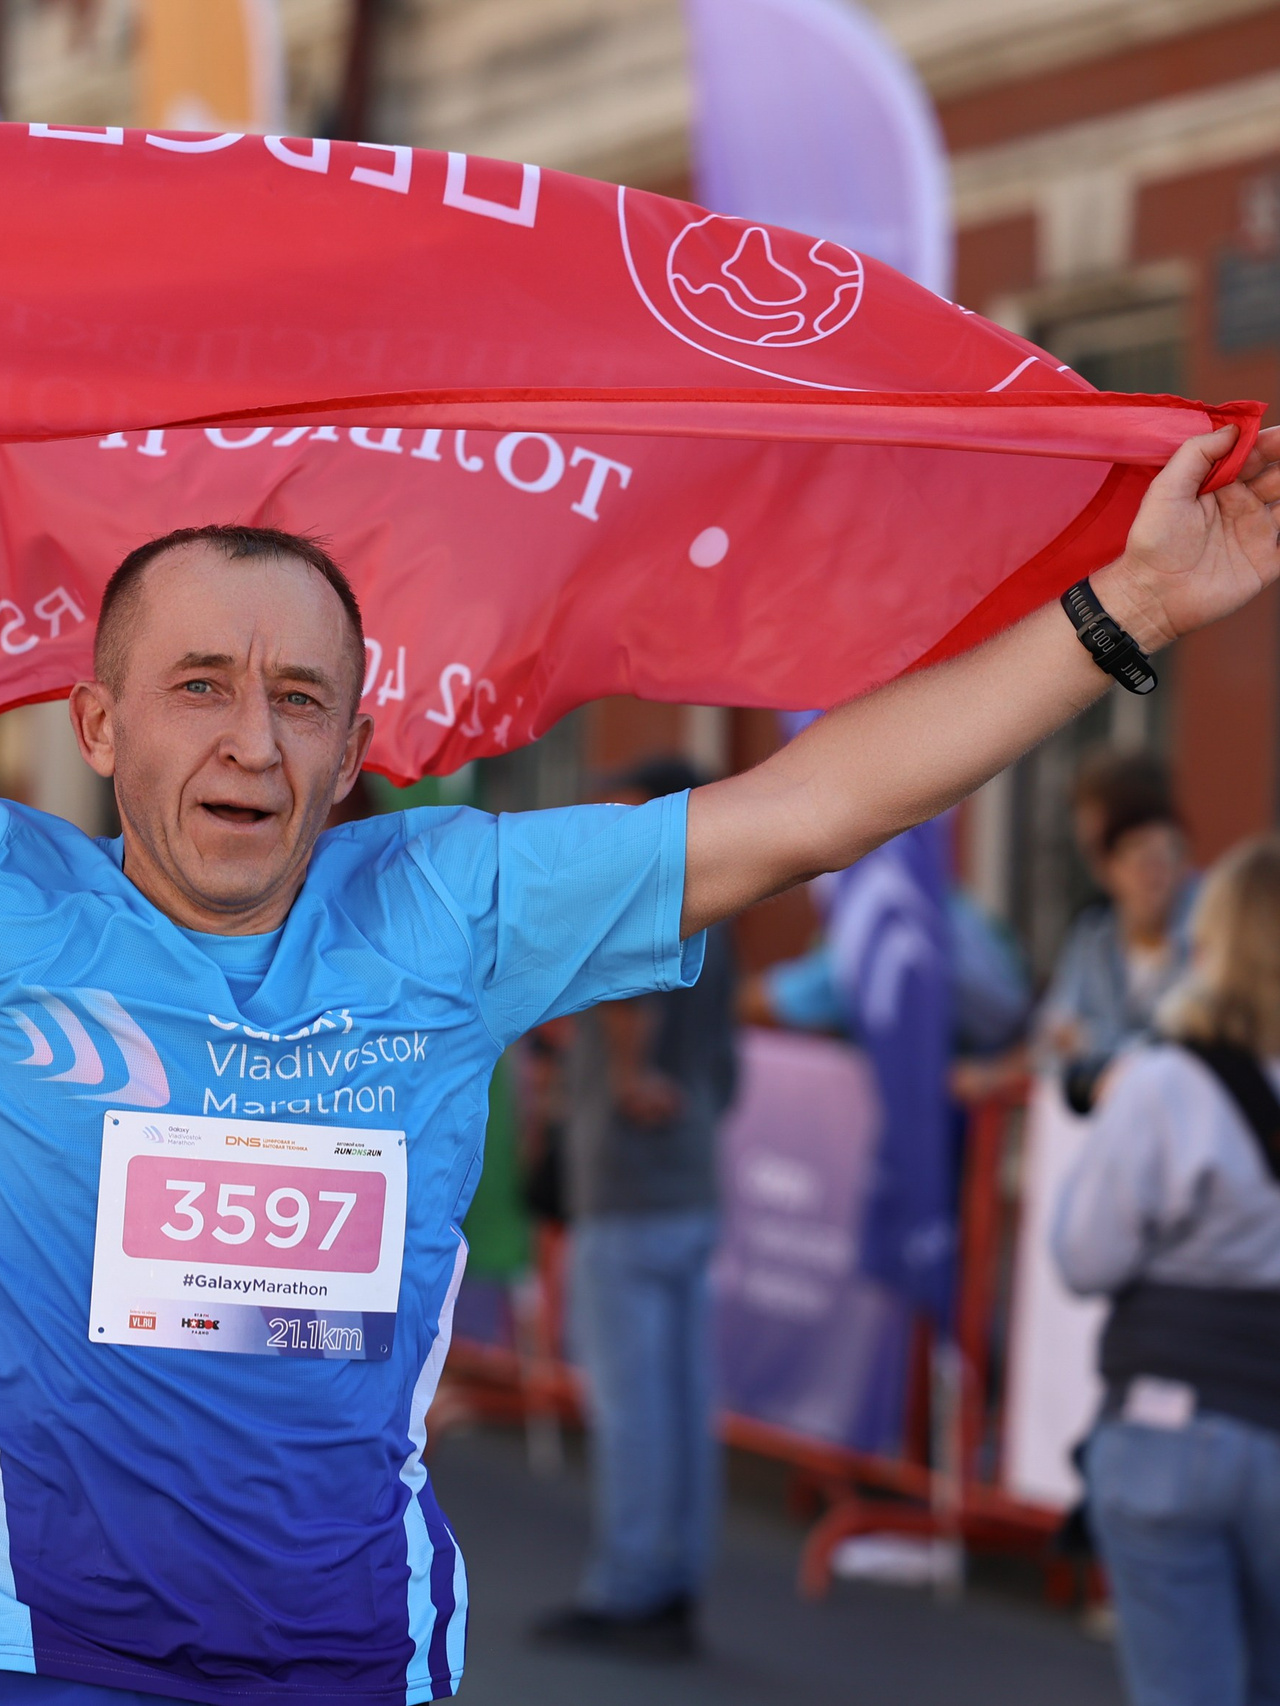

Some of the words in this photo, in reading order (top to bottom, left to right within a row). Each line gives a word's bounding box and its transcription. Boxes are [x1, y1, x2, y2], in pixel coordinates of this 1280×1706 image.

[206, 1030, 429, 1080] Vladivostok
[168, 1126, 190, 1134] Galaxy
[225, 1135, 261, 1148] DNS
[159, 1179, 357, 1251] 3597
[182, 1273, 328, 1297] #GalaxyMarathon
[132, 1316, 153, 1328] VL.RU
[267, 1317, 363, 1351] 21.1km
